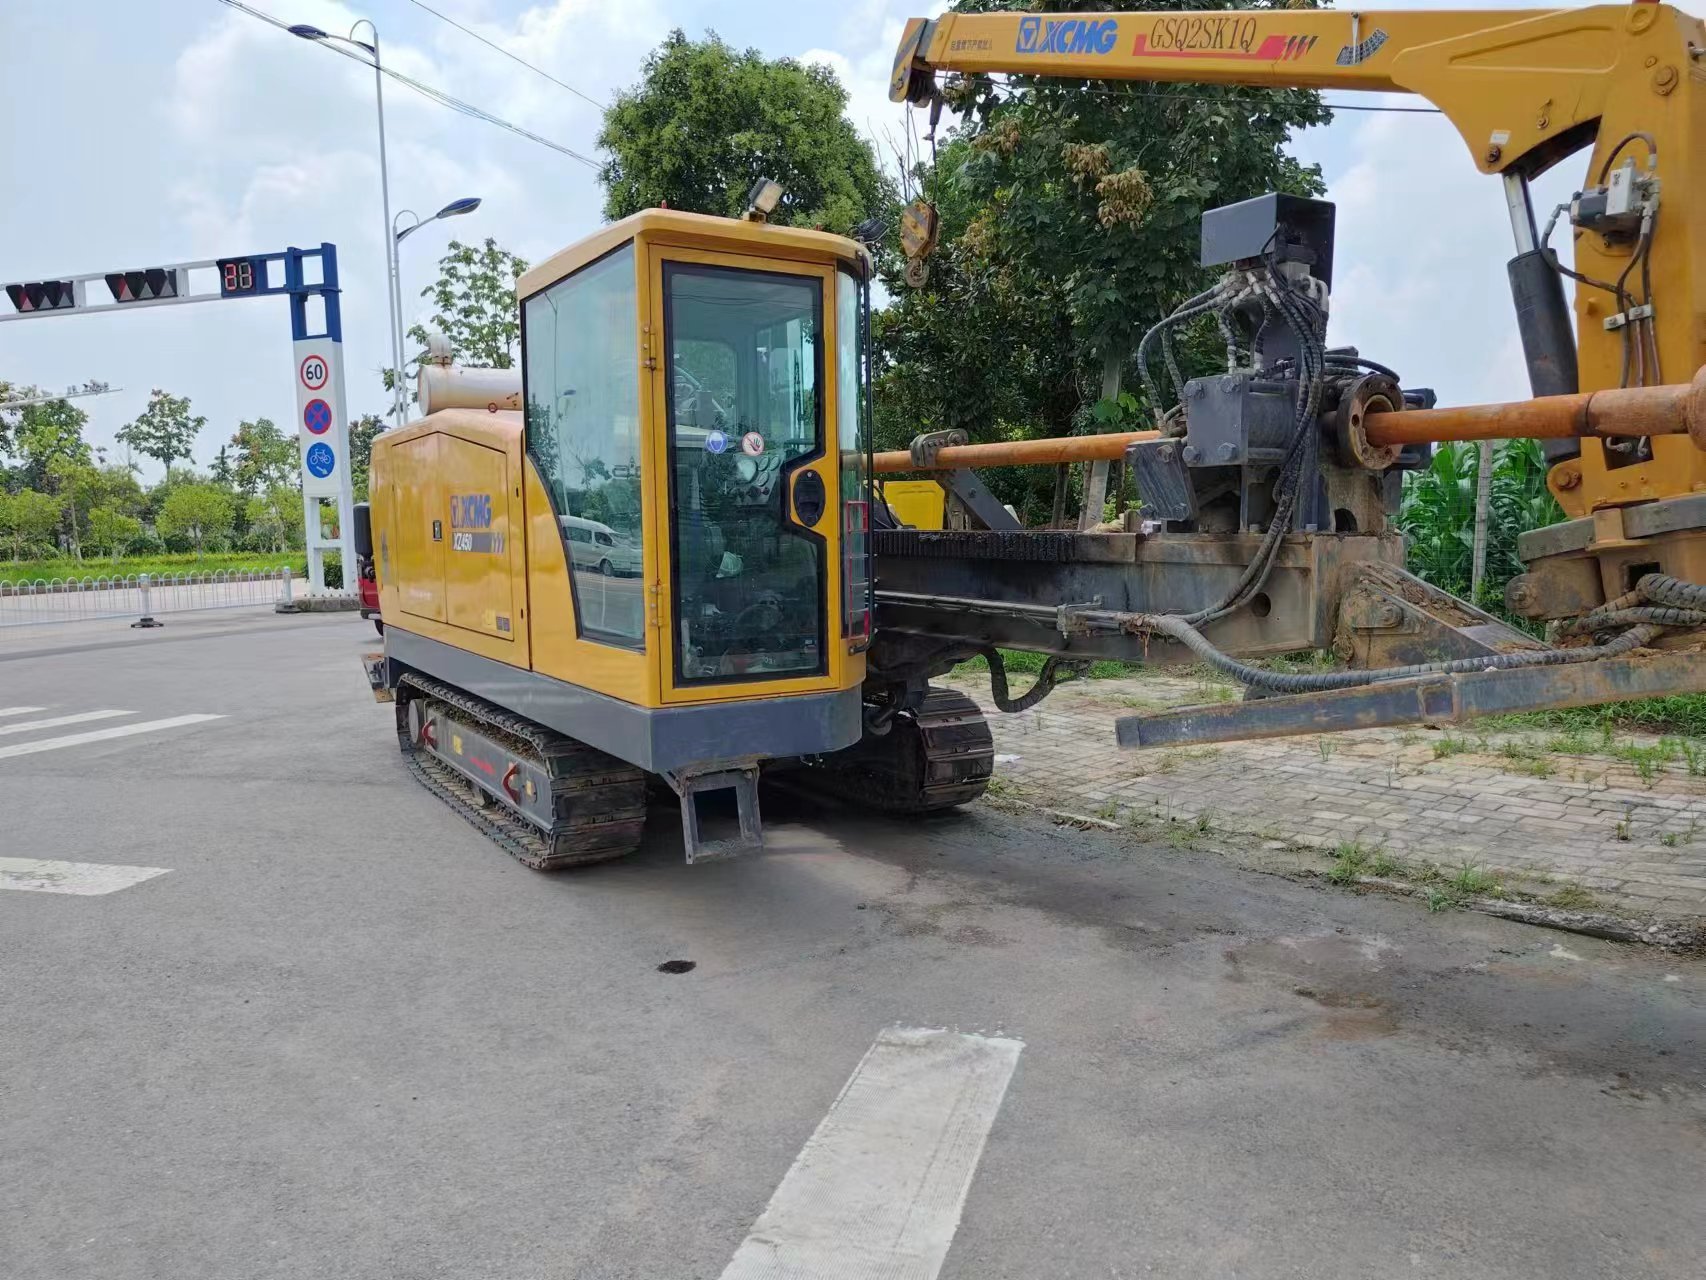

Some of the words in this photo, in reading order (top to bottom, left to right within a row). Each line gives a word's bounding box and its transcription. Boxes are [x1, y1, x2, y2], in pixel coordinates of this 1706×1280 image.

[1040, 18, 1118, 55] XCMG
[1150, 17, 1257, 53] GSQ2SK1Q
[306, 363, 323, 380] 60
[461, 494, 492, 529] XCMG
[453, 532, 473, 551] XZ450
